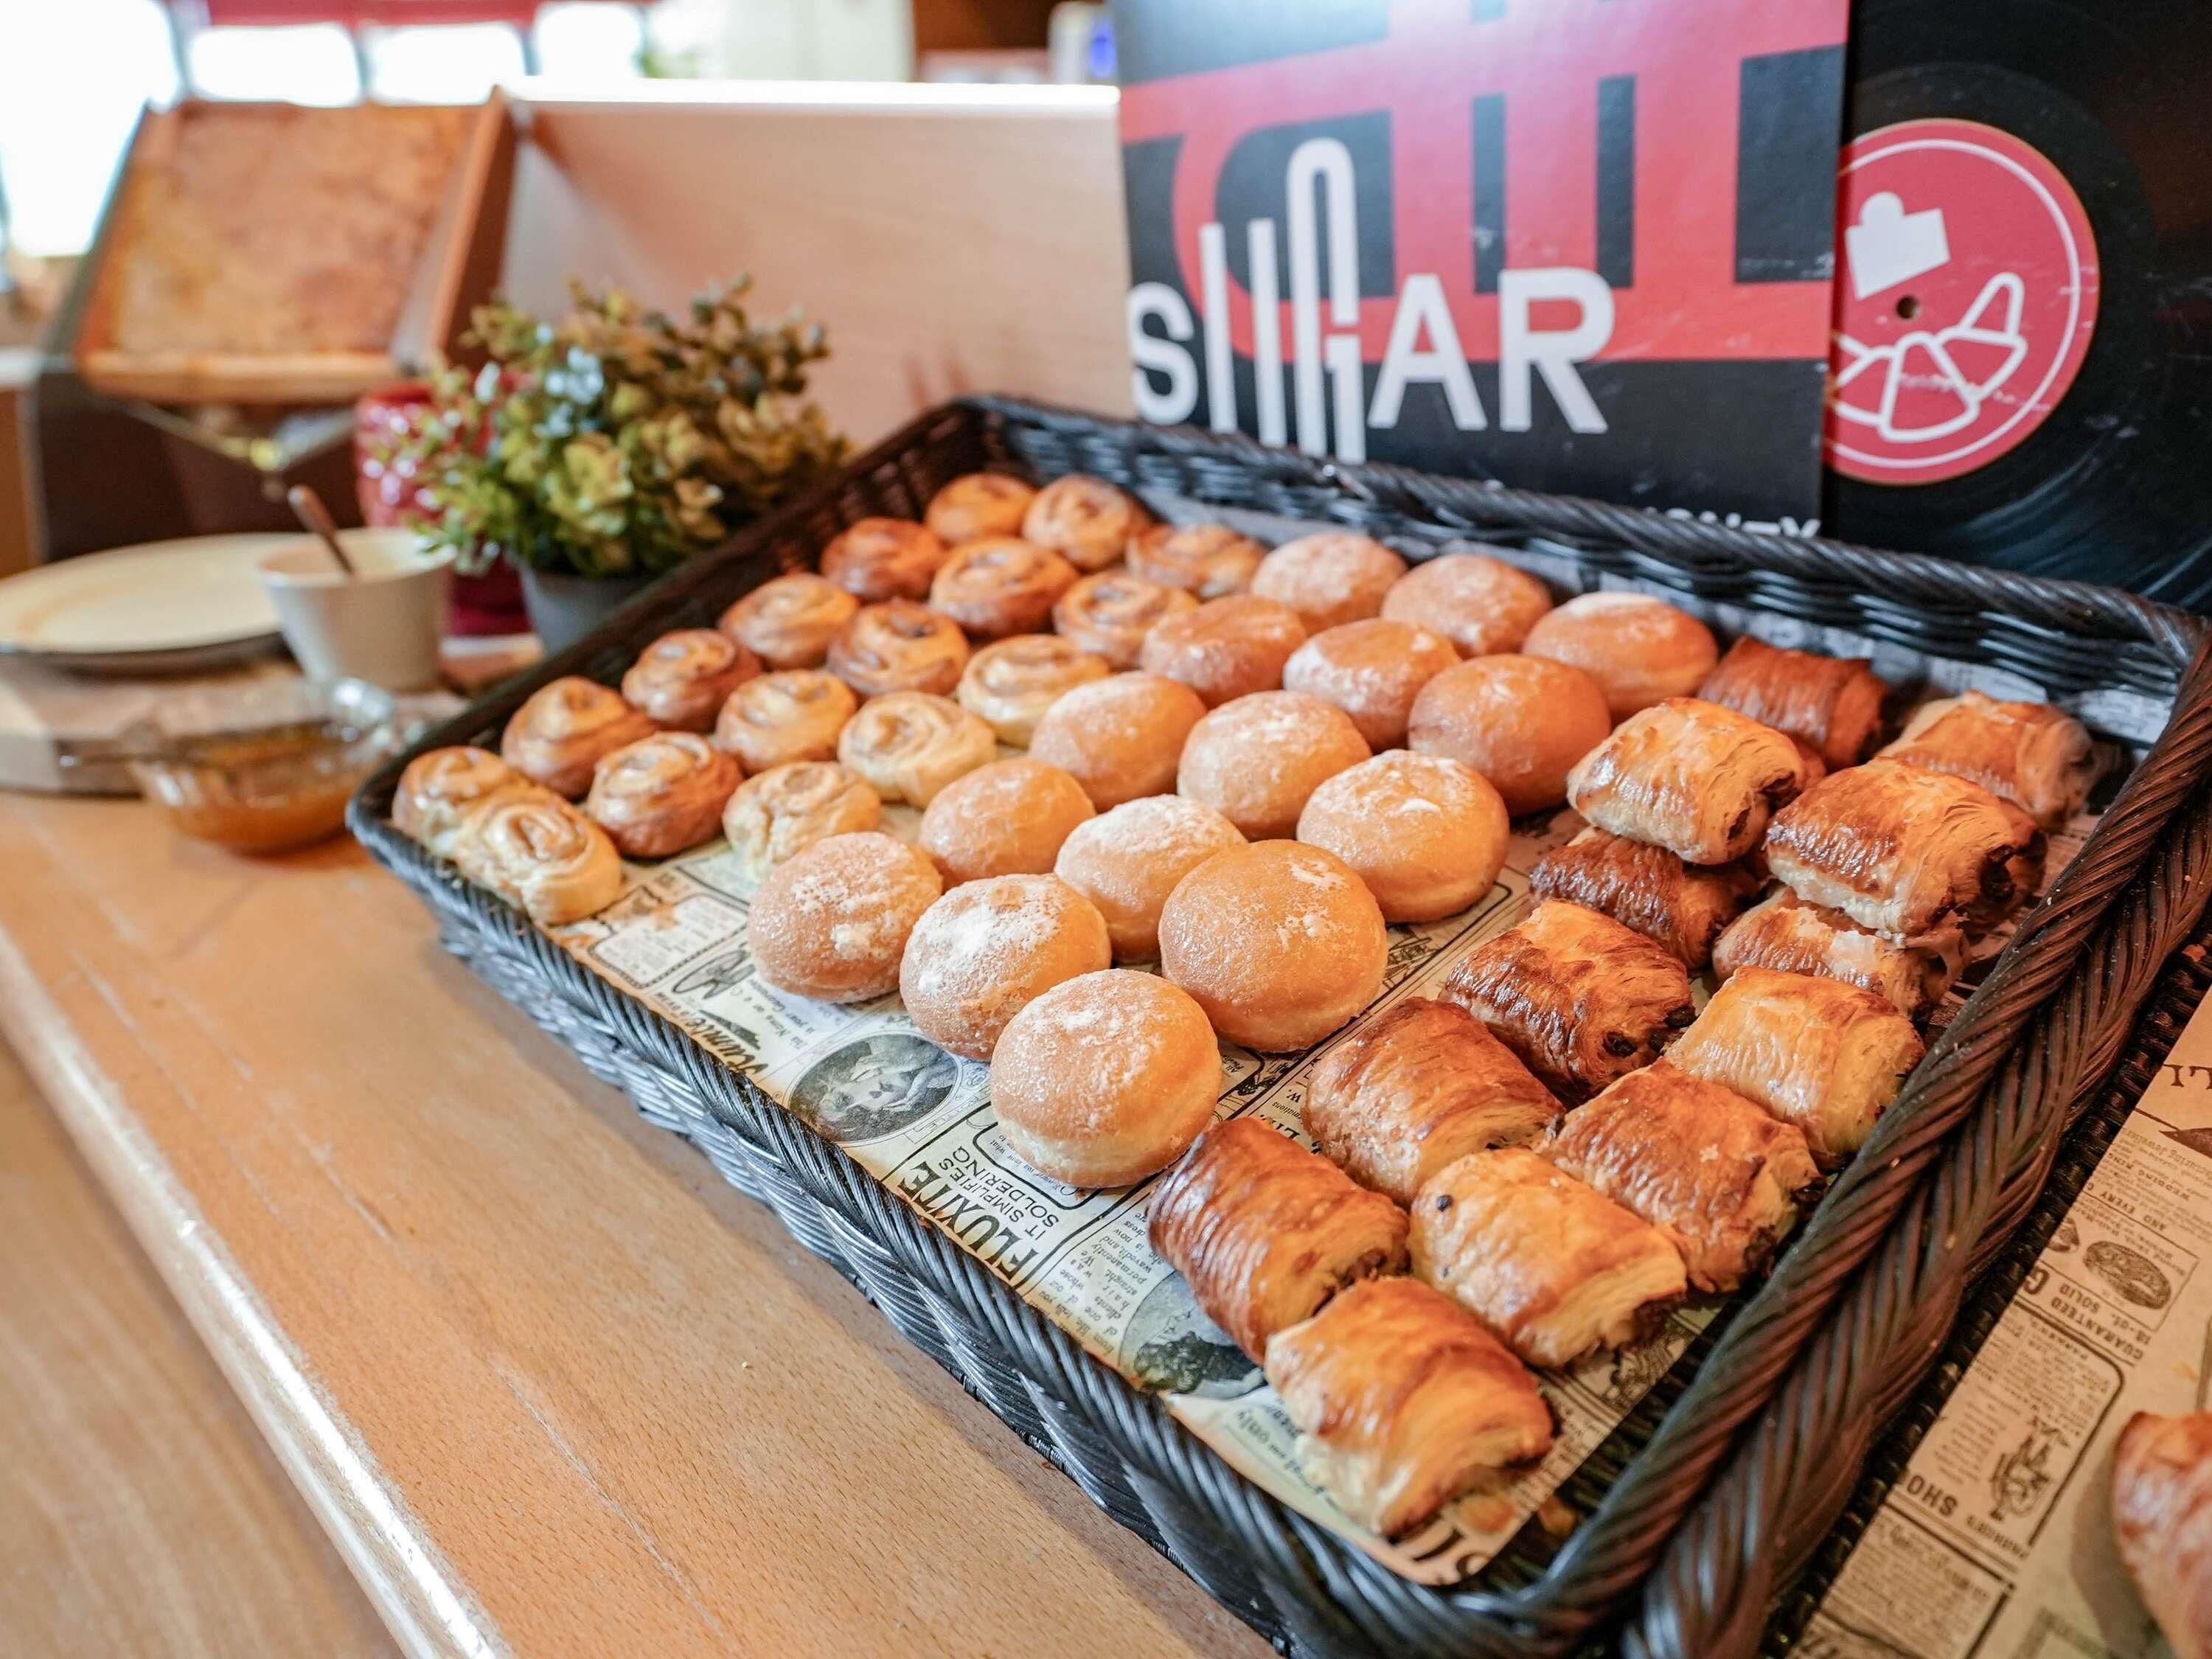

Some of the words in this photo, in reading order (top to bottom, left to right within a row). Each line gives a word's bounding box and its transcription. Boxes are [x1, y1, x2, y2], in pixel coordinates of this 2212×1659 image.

[1286, 1089, 1301, 1103] W.
[1272, 1102, 1301, 1120] rmations
[990, 1139, 1006, 1153] what
[939, 1158, 1024, 1223] SIMPLIFIES
[953, 1146, 1059, 1228] SOLDERING
[2100, 1191, 2135, 1214] EVERY
[897, 1161, 1039, 1281] FLUXITE
[1124, 1220, 1146, 1237] dress
[2143, 1214, 2166, 1232] AND
[1024, 1224, 1046, 1240] IT
[1113, 1228, 1132, 1243] now
[1135, 1243, 1144, 1251] is
[1081, 1250, 1096, 1267] We
[1091, 1243, 1147, 1284] permanently
[1070, 1259, 1092, 1279] was
[1050, 1281, 1063, 1293] our
[1060, 1269, 1084, 1291] whose
[1105, 1269, 1138, 1295] straight.
[1094, 1295, 1121, 1320] clients
[1102, 1286, 1130, 1310] hair
[2059, 1283, 2100, 1313] SOLID
[1085, 1307, 1102, 1321] one
[2052, 1295, 2143, 1362] GUARANTEED
